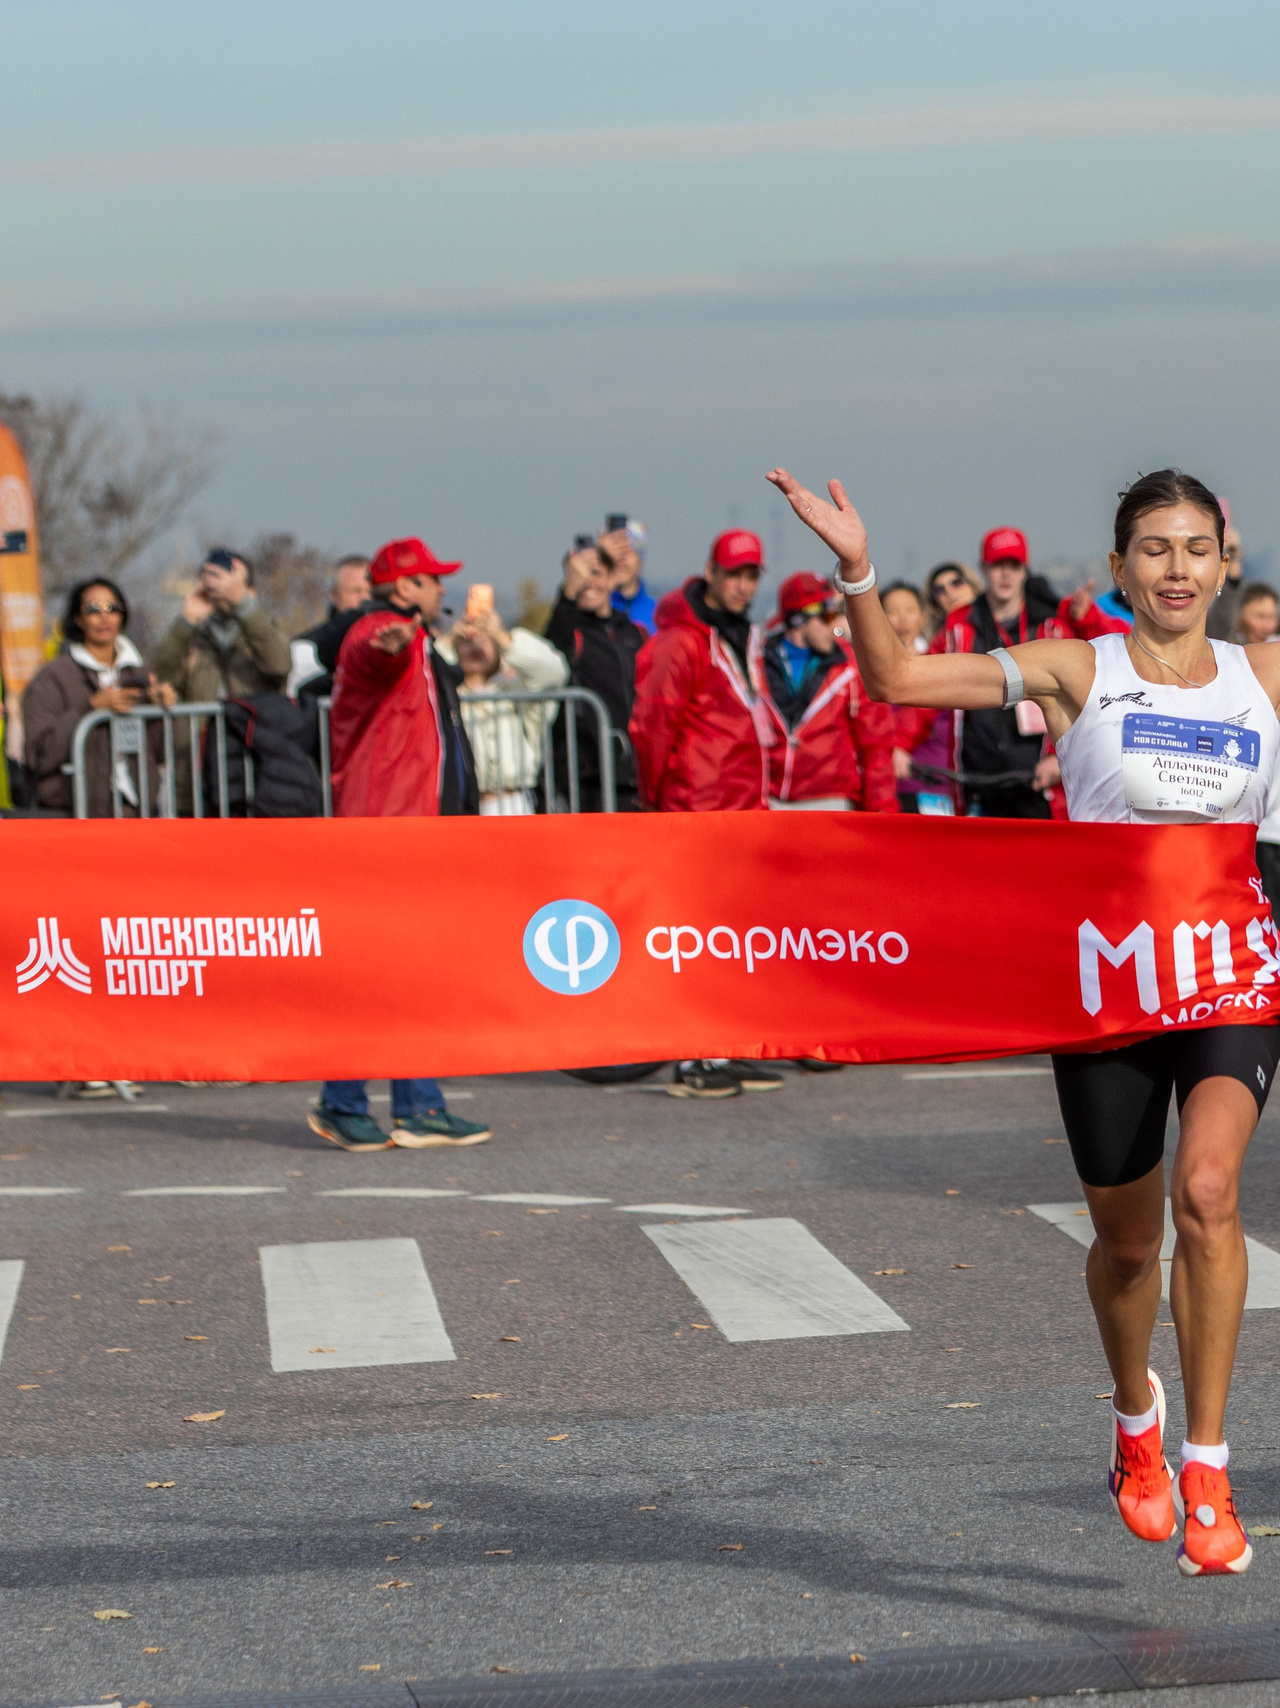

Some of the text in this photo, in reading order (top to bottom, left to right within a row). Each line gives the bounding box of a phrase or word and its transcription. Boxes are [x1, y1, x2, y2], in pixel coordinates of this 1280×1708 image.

[1134, 736, 1188, 749] МОЯ СТОЛИЦА
[1153, 756, 1228, 778] Аплачкина
[1158, 770, 1222, 791] Светлана
[1180, 787, 1204, 798] 16012
[100, 908, 322, 957] МОСКОВСКИЙ
[645, 925, 910, 973] фармэко
[105, 959, 207, 996] СПОРТ
